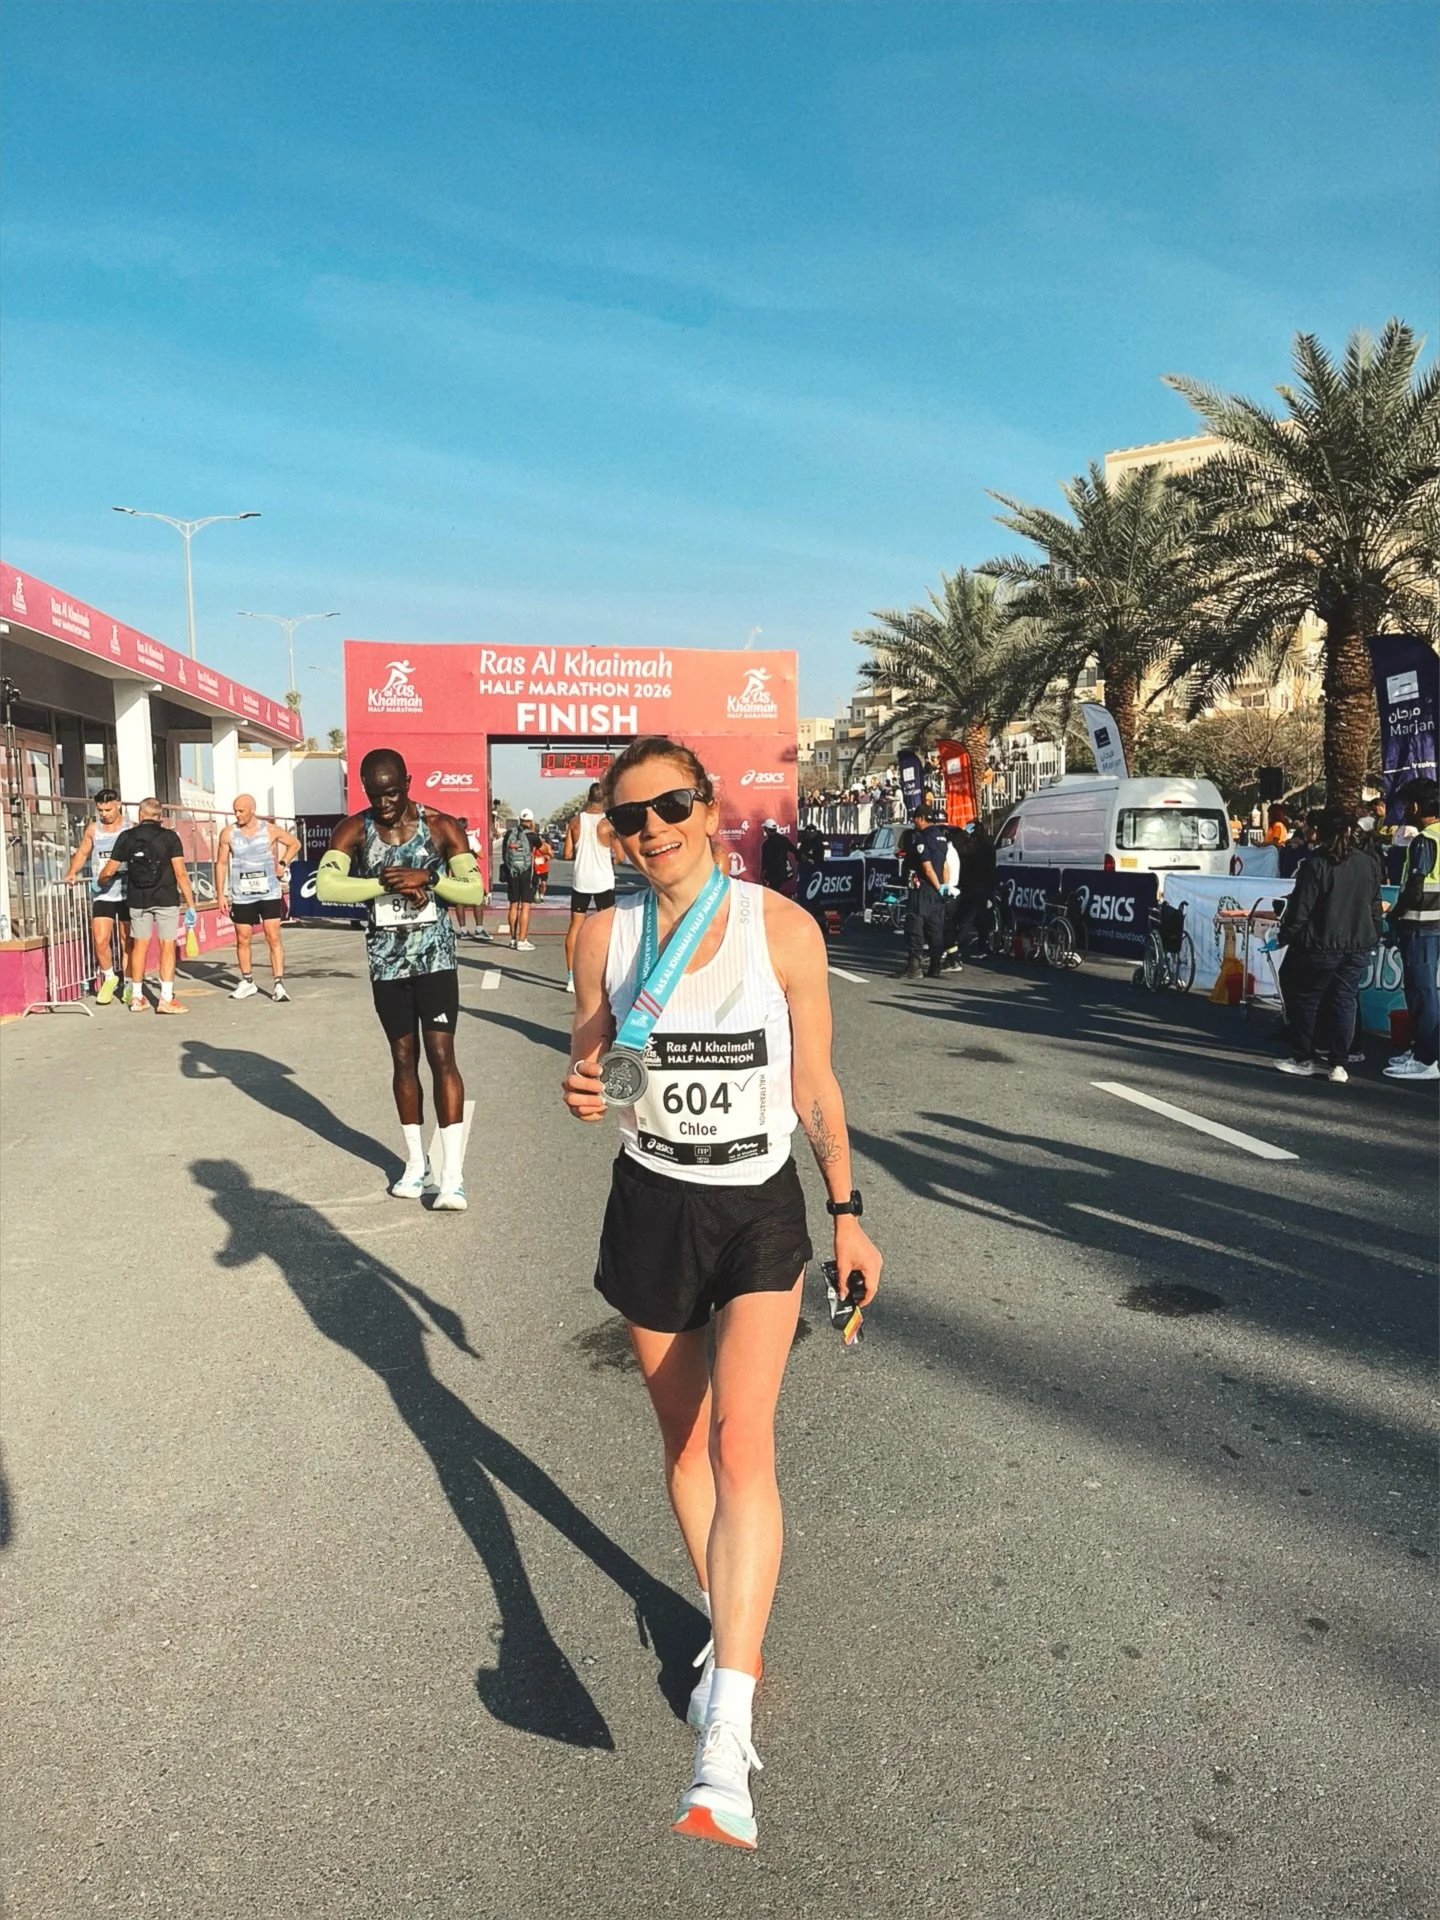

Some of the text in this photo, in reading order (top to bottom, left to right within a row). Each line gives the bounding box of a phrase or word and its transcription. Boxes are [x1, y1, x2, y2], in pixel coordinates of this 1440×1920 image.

[480, 648, 672, 678] Ras Al Khaimah
[368, 687, 422, 707] Khaimah
[480, 679, 672, 698] HALF MARATHON 2026
[727, 695, 777, 713] Khaimah
[517, 702, 638, 734] FINISH
[1390, 719, 1435, 737] Marjan
[441, 774, 473, 785] asics
[755, 772, 785, 784] asics
[821, 875, 853, 894] asics
[1015, 886, 1046, 910] asics
[1089, 894, 1136, 922] asics
[653, 874, 725, 995] RAS AL KHAIMAH HALF MARATHON
[666, 1039, 755, 1053] Ras Al Khaimah
[667, 1053, 754, 1064] HALF MARATHON
[662, 1081, 733, 1116] 604
[679, 1121, 718, 1136] Chloe
[655, 1142, 674, 1155] asics
